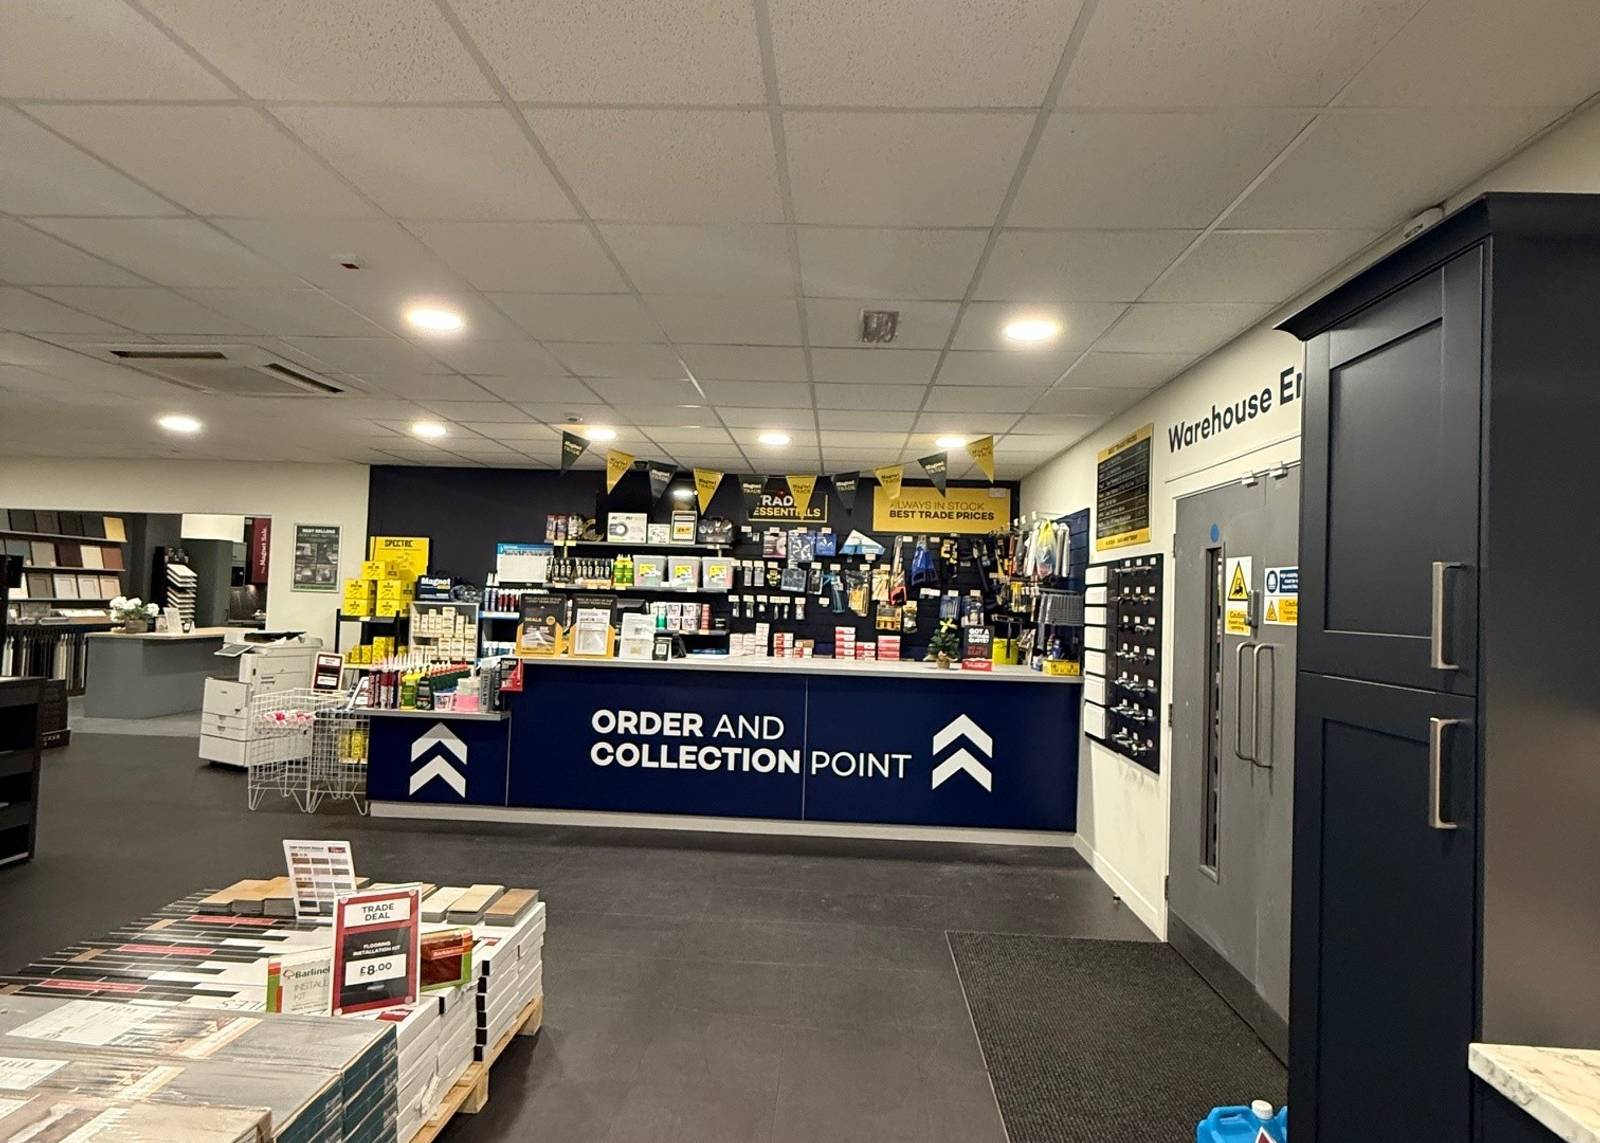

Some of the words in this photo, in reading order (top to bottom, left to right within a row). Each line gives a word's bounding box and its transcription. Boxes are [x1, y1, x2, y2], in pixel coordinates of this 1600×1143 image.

[1168, 387, 1272, 454] Warehouse
[757, 494, 796, 506] RAD
[889, 500, 932, 511] ALWAYS
[934, 501, 945, 511] IN
[947, 501, 986, 512] STOCK
[753, 507, 821, 517] ESSENTILS
[889, 510, 916, 519] BEST
[918, 511, 955, 520] TRADE
[956, 512, 995, 521] PRICES
[421, 577, 451, 587] Magnet
[592, 709, 704, 738] ORDER
[712, 714, 785, 741] AND
[590, 741, 801, 774] COLLECTION
[811, 751, 912, 779] POINT
[361, 902, 395, 914] TRADE
[364, 911, 391, 922] DEAL
[360, 962, 393, 977] £8.00
